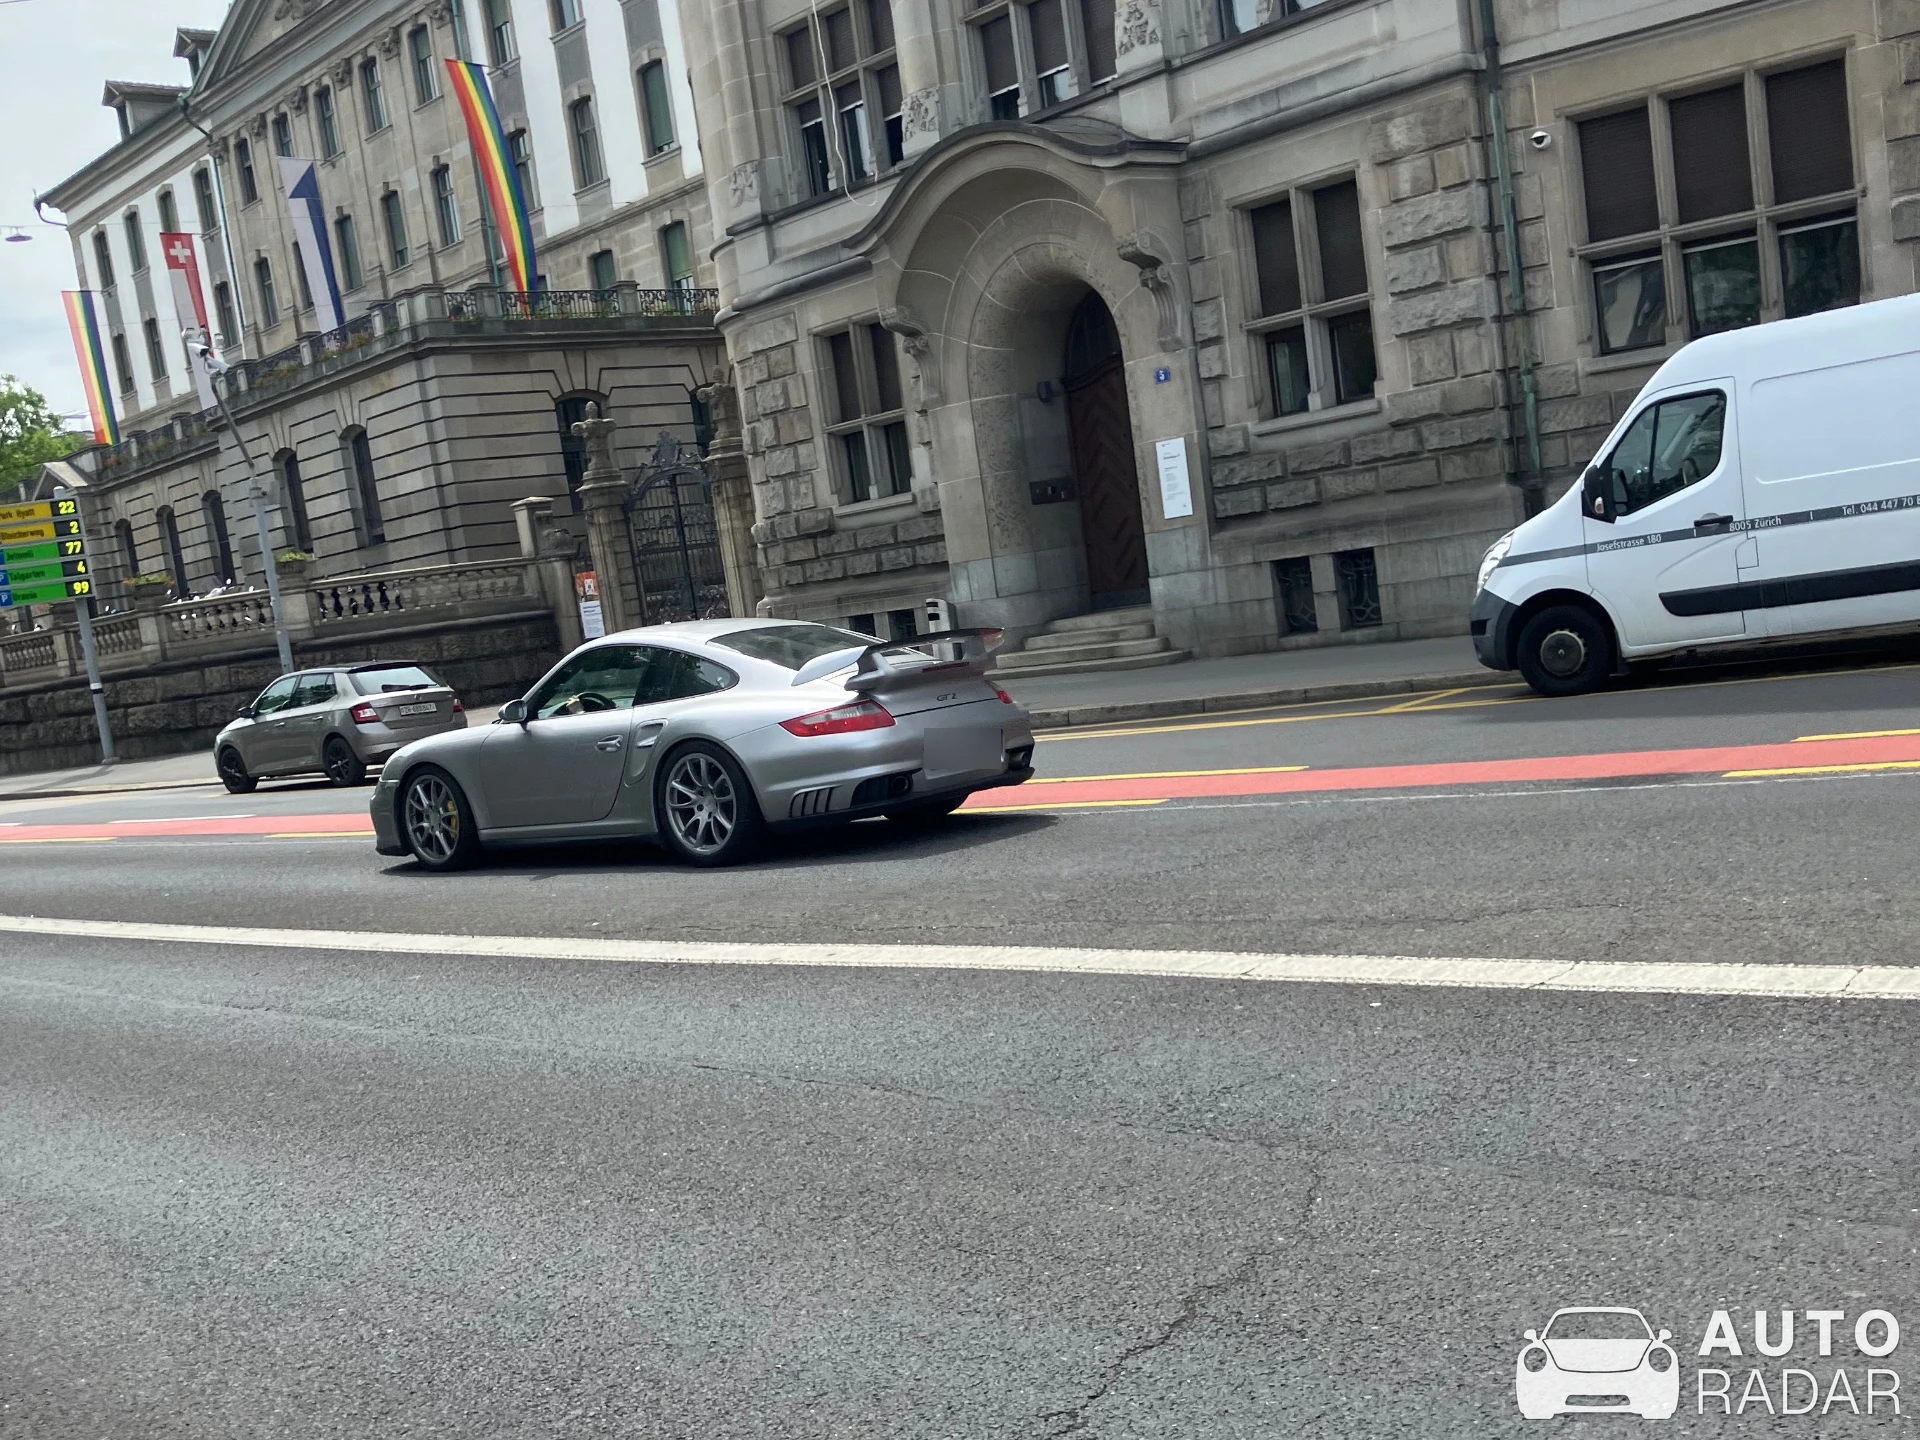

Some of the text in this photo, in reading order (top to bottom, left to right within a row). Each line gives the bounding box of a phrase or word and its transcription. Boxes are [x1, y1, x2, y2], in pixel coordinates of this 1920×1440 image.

[58, 501, 76, 514] 22
[69, 521, 79, 534] 2
[1596, 537, 1645, 552] Josefstrasse
[1647, 533, 1662, 545] 180
[1729, 520, 1752, 532] 8005
[1754, 516, 1782, 529] Zürich
[1842, 504, 1858, 516] Tel.
[1860, 502, 1878, 513] 044
[1881, 499, 1898, 510] 447
[1901, 496, 1914, 507] 70
[65, 541, 82, 554] 77
[77, 561, 86, 573] 4
[73, 581, 89, 594] 99
